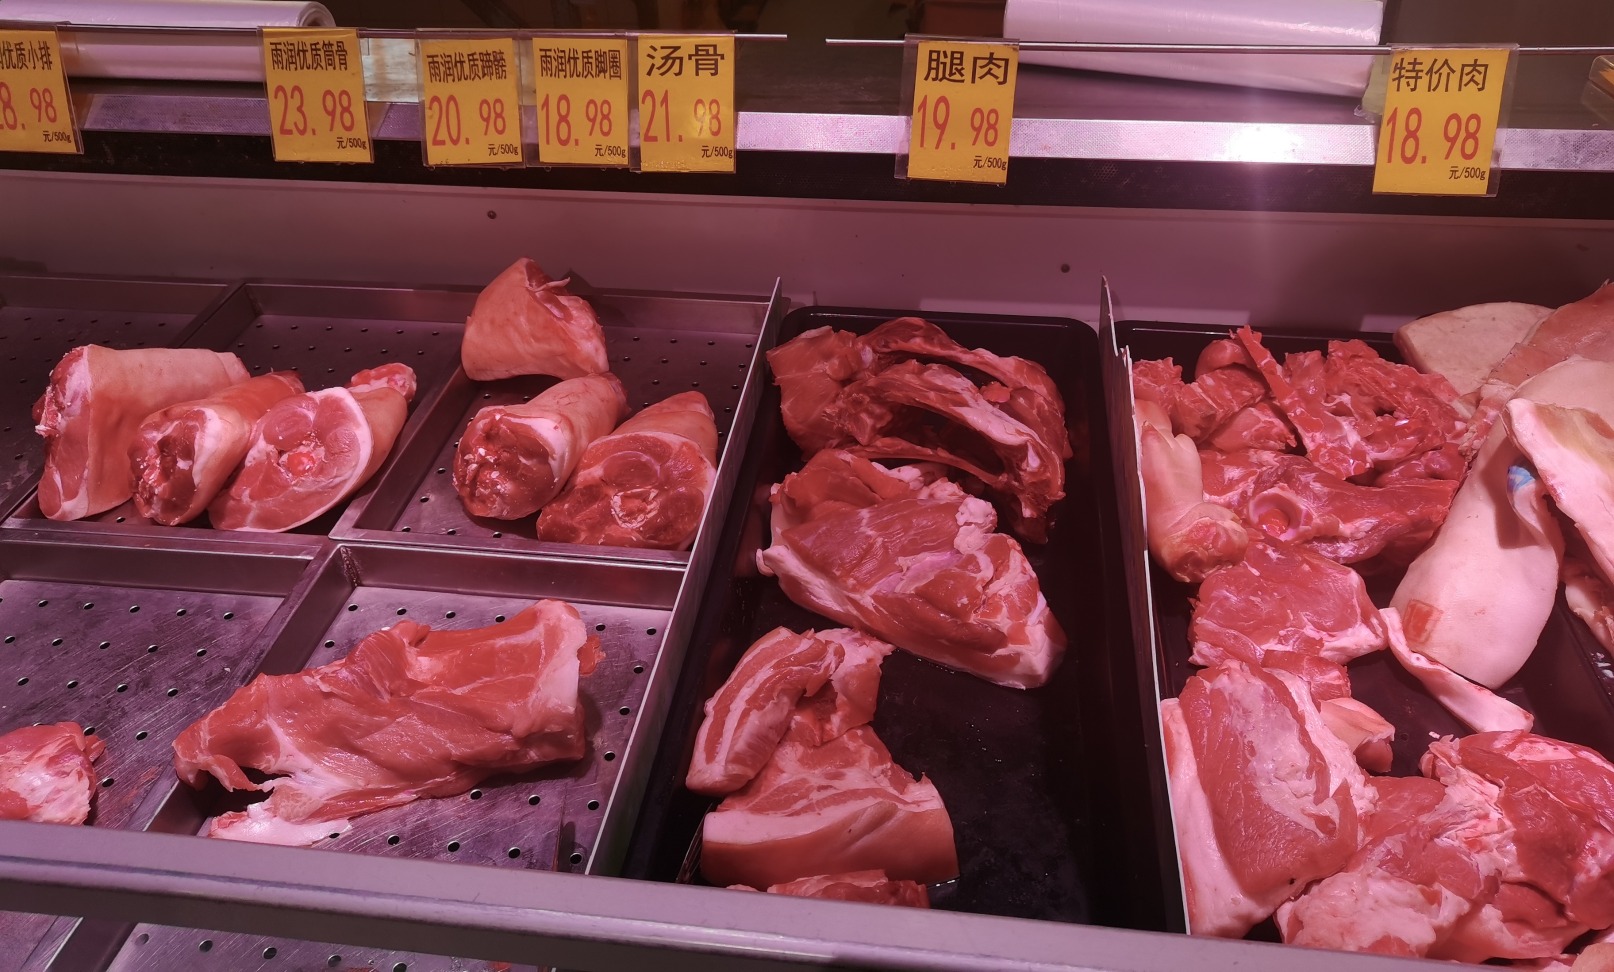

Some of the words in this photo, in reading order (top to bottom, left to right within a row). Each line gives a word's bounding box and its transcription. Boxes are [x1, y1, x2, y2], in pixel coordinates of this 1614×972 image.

[270, 40, 348, 72] 雨润优质筒骨
[539, 47, 622, 81] 雨润优质脚圈
[645, 43, 725, 77] 汤骨
[924, 49, 1010, 85] 腿肉
[1391, 57, 1489, 92] 特价肉
[0, 82, 57, 130] 8.98
[274, 84, 355, 136] 23.98
[428, 94, 507, 147] 20.98
[540, 93, 613, 147] 18.98
[641, 89, 722, 143] 21.98
[917, 94, 1000, 151] 19.98
[43, 130, 72, 143] 元/500g
[336, 136, 367, 150] 元/500g
[487, 143, 519, 157] 元/500g
[594, 144, 627, 158] 元/500g
[701, 145, 734, 159] 元/500g
[1386, 106, 1482, 165] 18.98
[973, 155, 1007, 170] 元/500g
[1448, 165, 1486, 180] 元/500g
